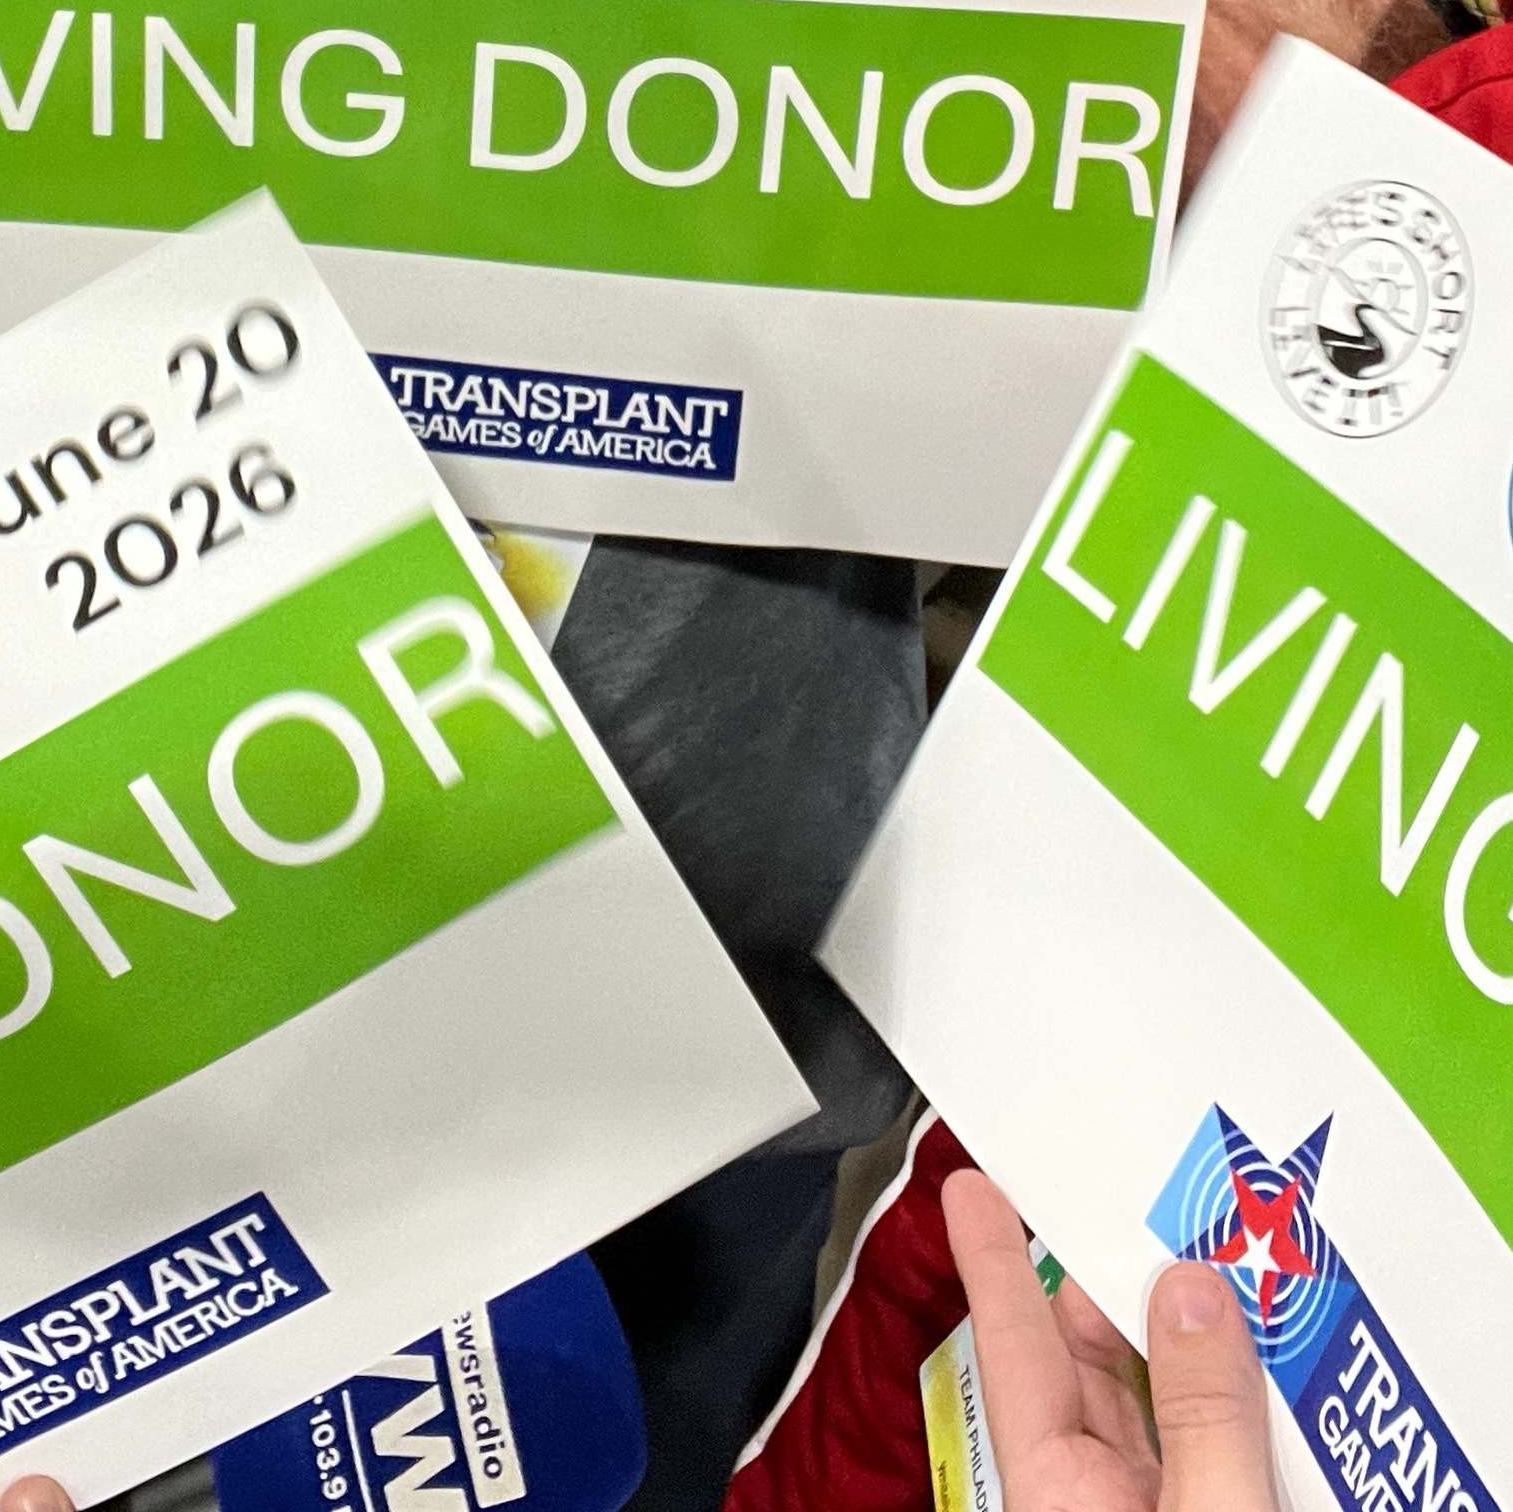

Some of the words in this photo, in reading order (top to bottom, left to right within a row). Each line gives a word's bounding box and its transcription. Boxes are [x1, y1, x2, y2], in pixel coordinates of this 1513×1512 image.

[469, 41, 1163, 219] DONOR
[167, 297, 305, 426] 20
[390, 366, 728, 439] TRANSPLANT
[526, 423, 559, 456] of
[555, 427, 717, 470] AMERICA
[44, 439, 298, 637] 2026
[75, 1351, 107, 1395] of
[113, 1268, 299, 1381] AMERICA
[959, 1364, 976, 1428] TEAM
[309, 1409, 349, 1501] 103.9
